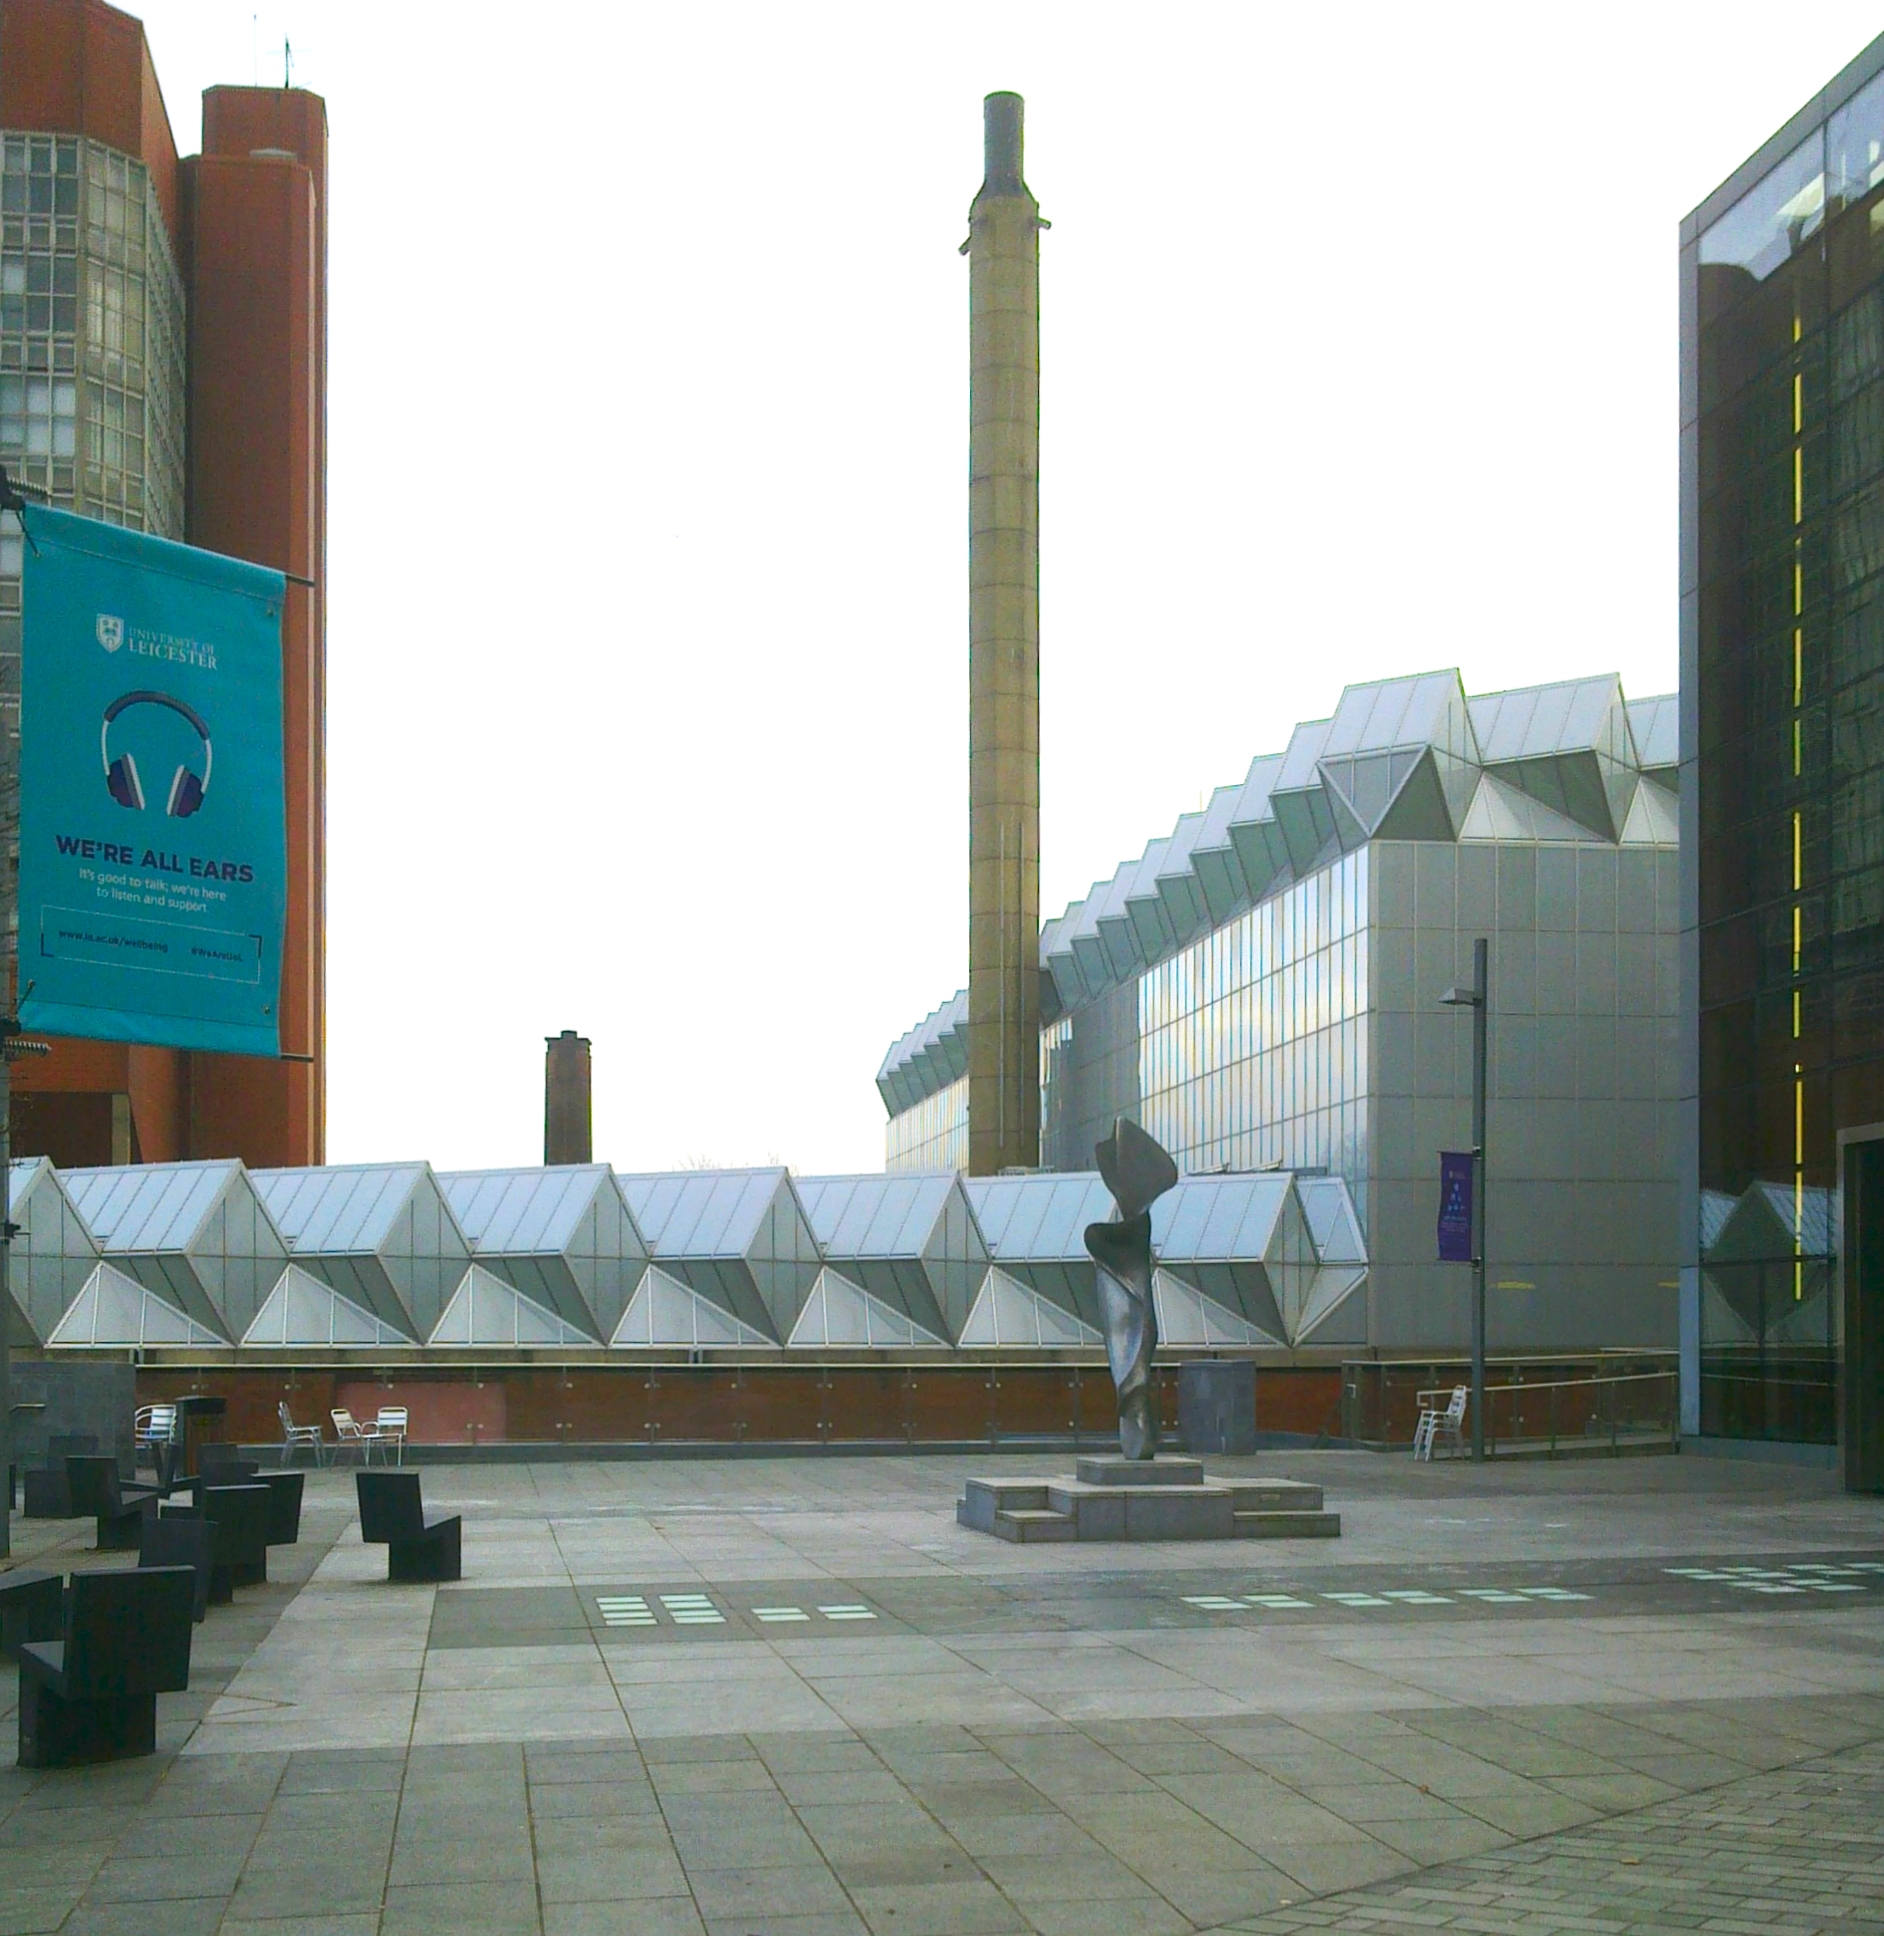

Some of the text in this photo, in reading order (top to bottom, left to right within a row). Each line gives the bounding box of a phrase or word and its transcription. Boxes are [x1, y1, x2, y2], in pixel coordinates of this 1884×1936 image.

[129, 626, 199, 652] UNIVERSITY
[128, 638, 218, 671] LEICESTER
[55, 834, 255, 883] WE'RE ALL EARS
[96, 887, 207, 913] to listen and support
[97, 873, 127, 886] good
[129, 876, 142, 888] to
[171, 883, 200, 898] we're
[202, 888, 227, 901] here
